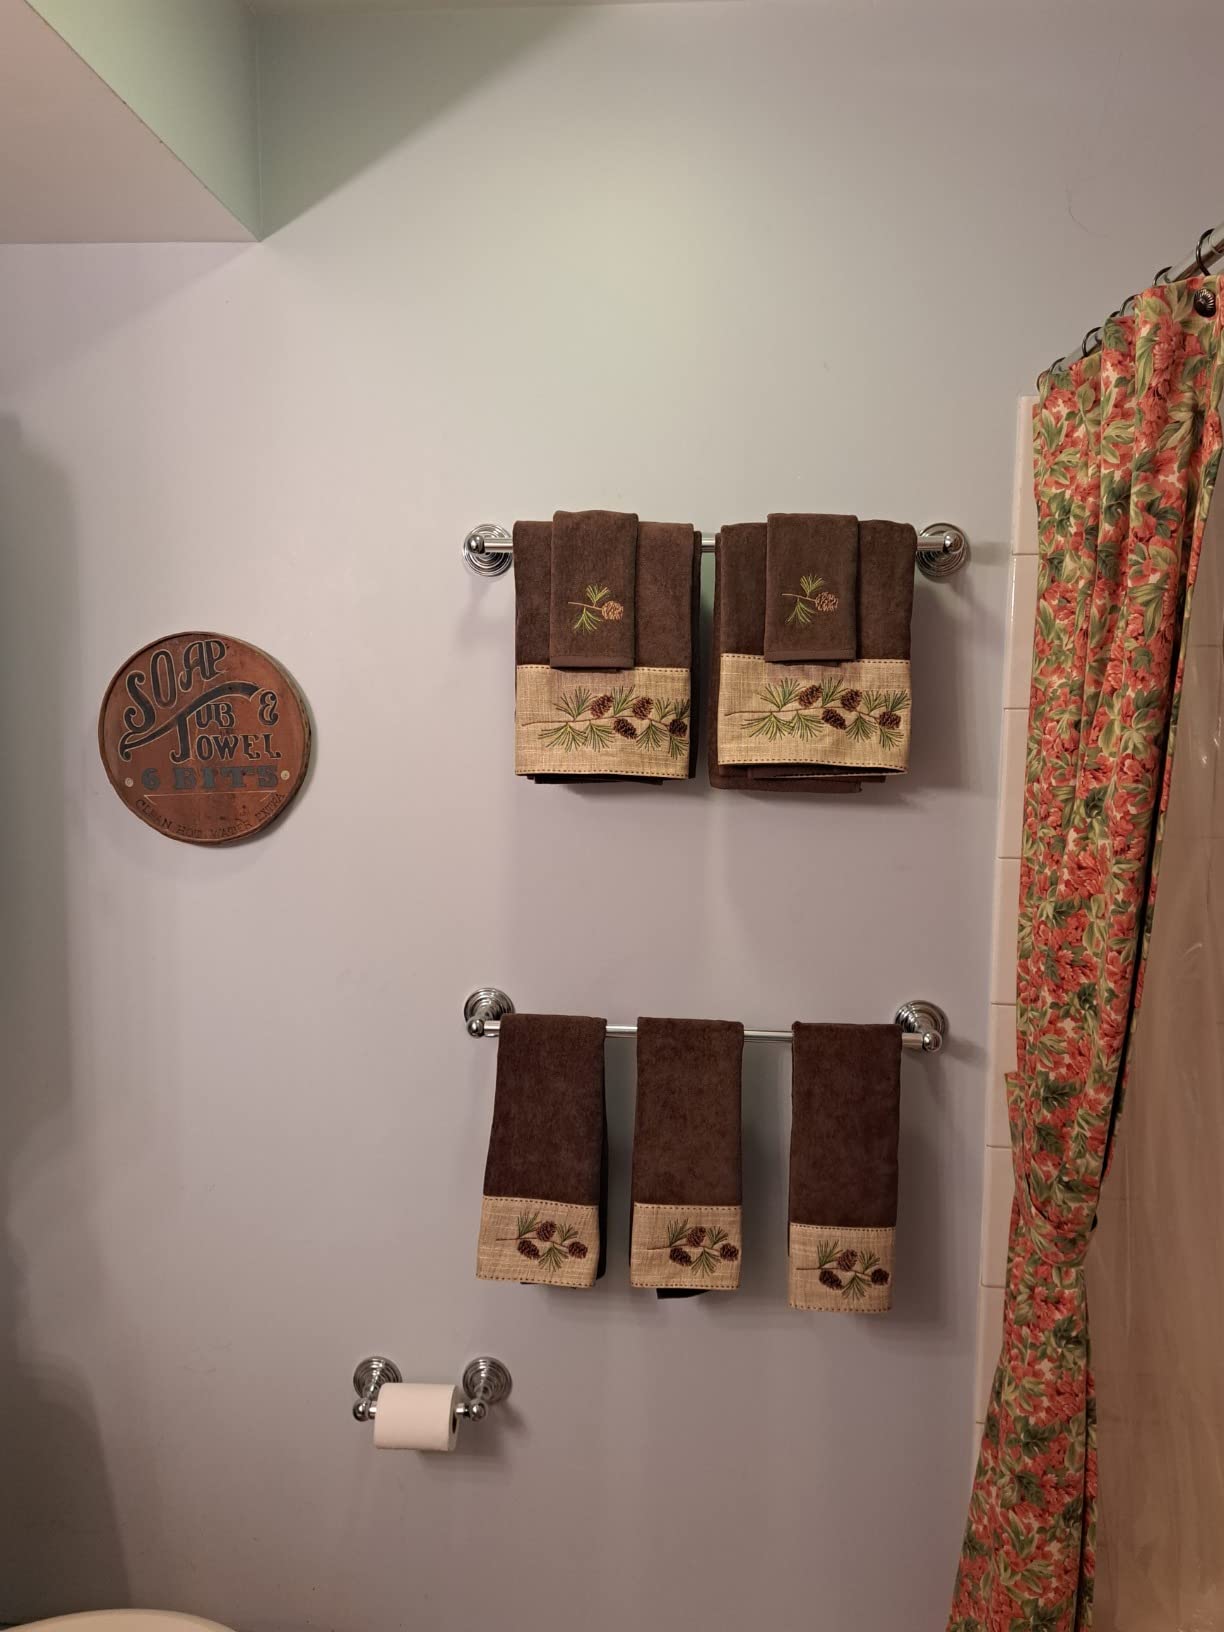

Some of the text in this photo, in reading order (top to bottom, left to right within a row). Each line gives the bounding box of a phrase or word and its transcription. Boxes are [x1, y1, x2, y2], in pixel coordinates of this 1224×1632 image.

[123, 639, 229, 733] SOAP
[258, 690, 280, 728] &
[169, 732, 281, 764] TOWEL
[141, 764, 280, 791] 6 BITS
[135, 798, 173, 830] CLEAN
[254, 793, 285, 822] EXTRA
